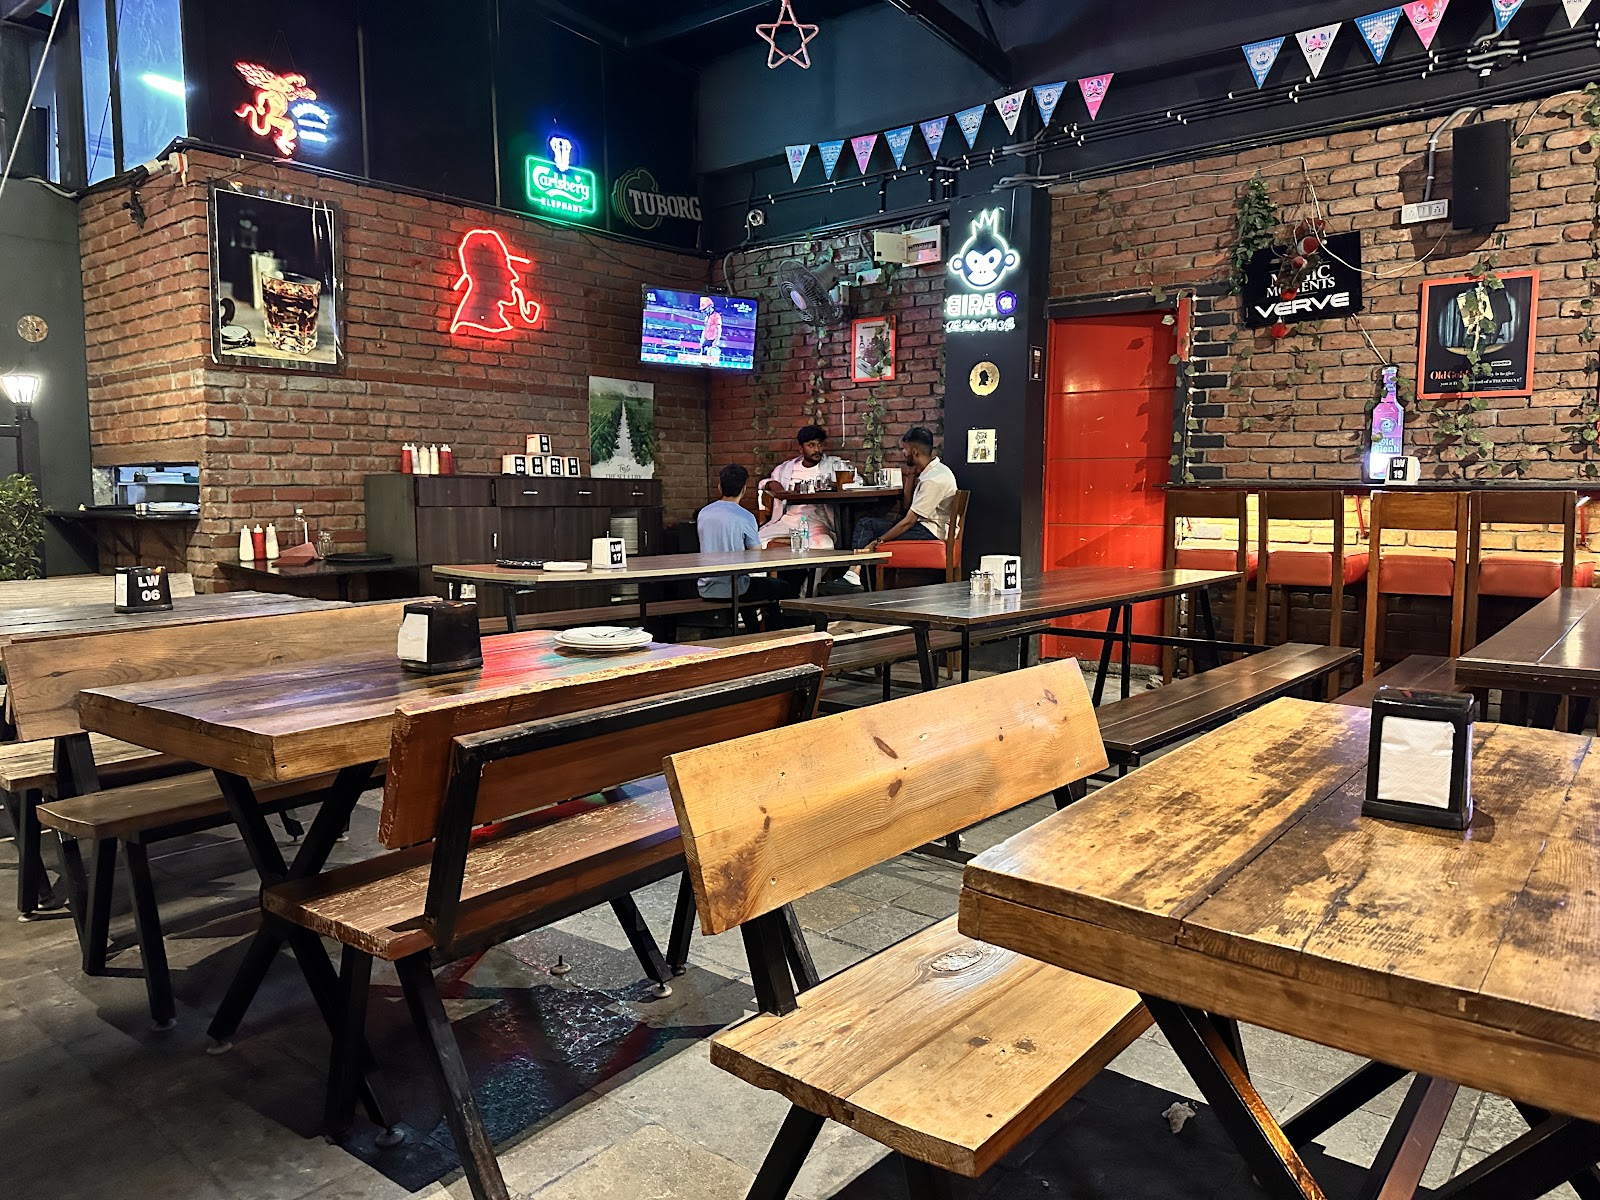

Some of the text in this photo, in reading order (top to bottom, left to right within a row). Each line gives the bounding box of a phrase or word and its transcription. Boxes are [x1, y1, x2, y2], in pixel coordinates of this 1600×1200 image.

[532, 165, 590, 201] Carlsberg
[541, 197, 583, 214] ELEPHANT
[628, 189, 703, 221] TUBORG
[947, 292, 997, 317] BIRA
[1254, 291, 1350, 319] VERVE
[1429, 370, 1447, 380] Old
[1392, 458, 1406, 468] LW
[1393, 469, 1404, 479] 19
[610, 543, 622, 552] LW
[612, 553, 622, 562] 17
[1005, 563, 1016, 574] LW
[137, 574, 160, 588] LW
[1006, 575, 1016, 586] 16
[141, 588, 161, 602] 06
